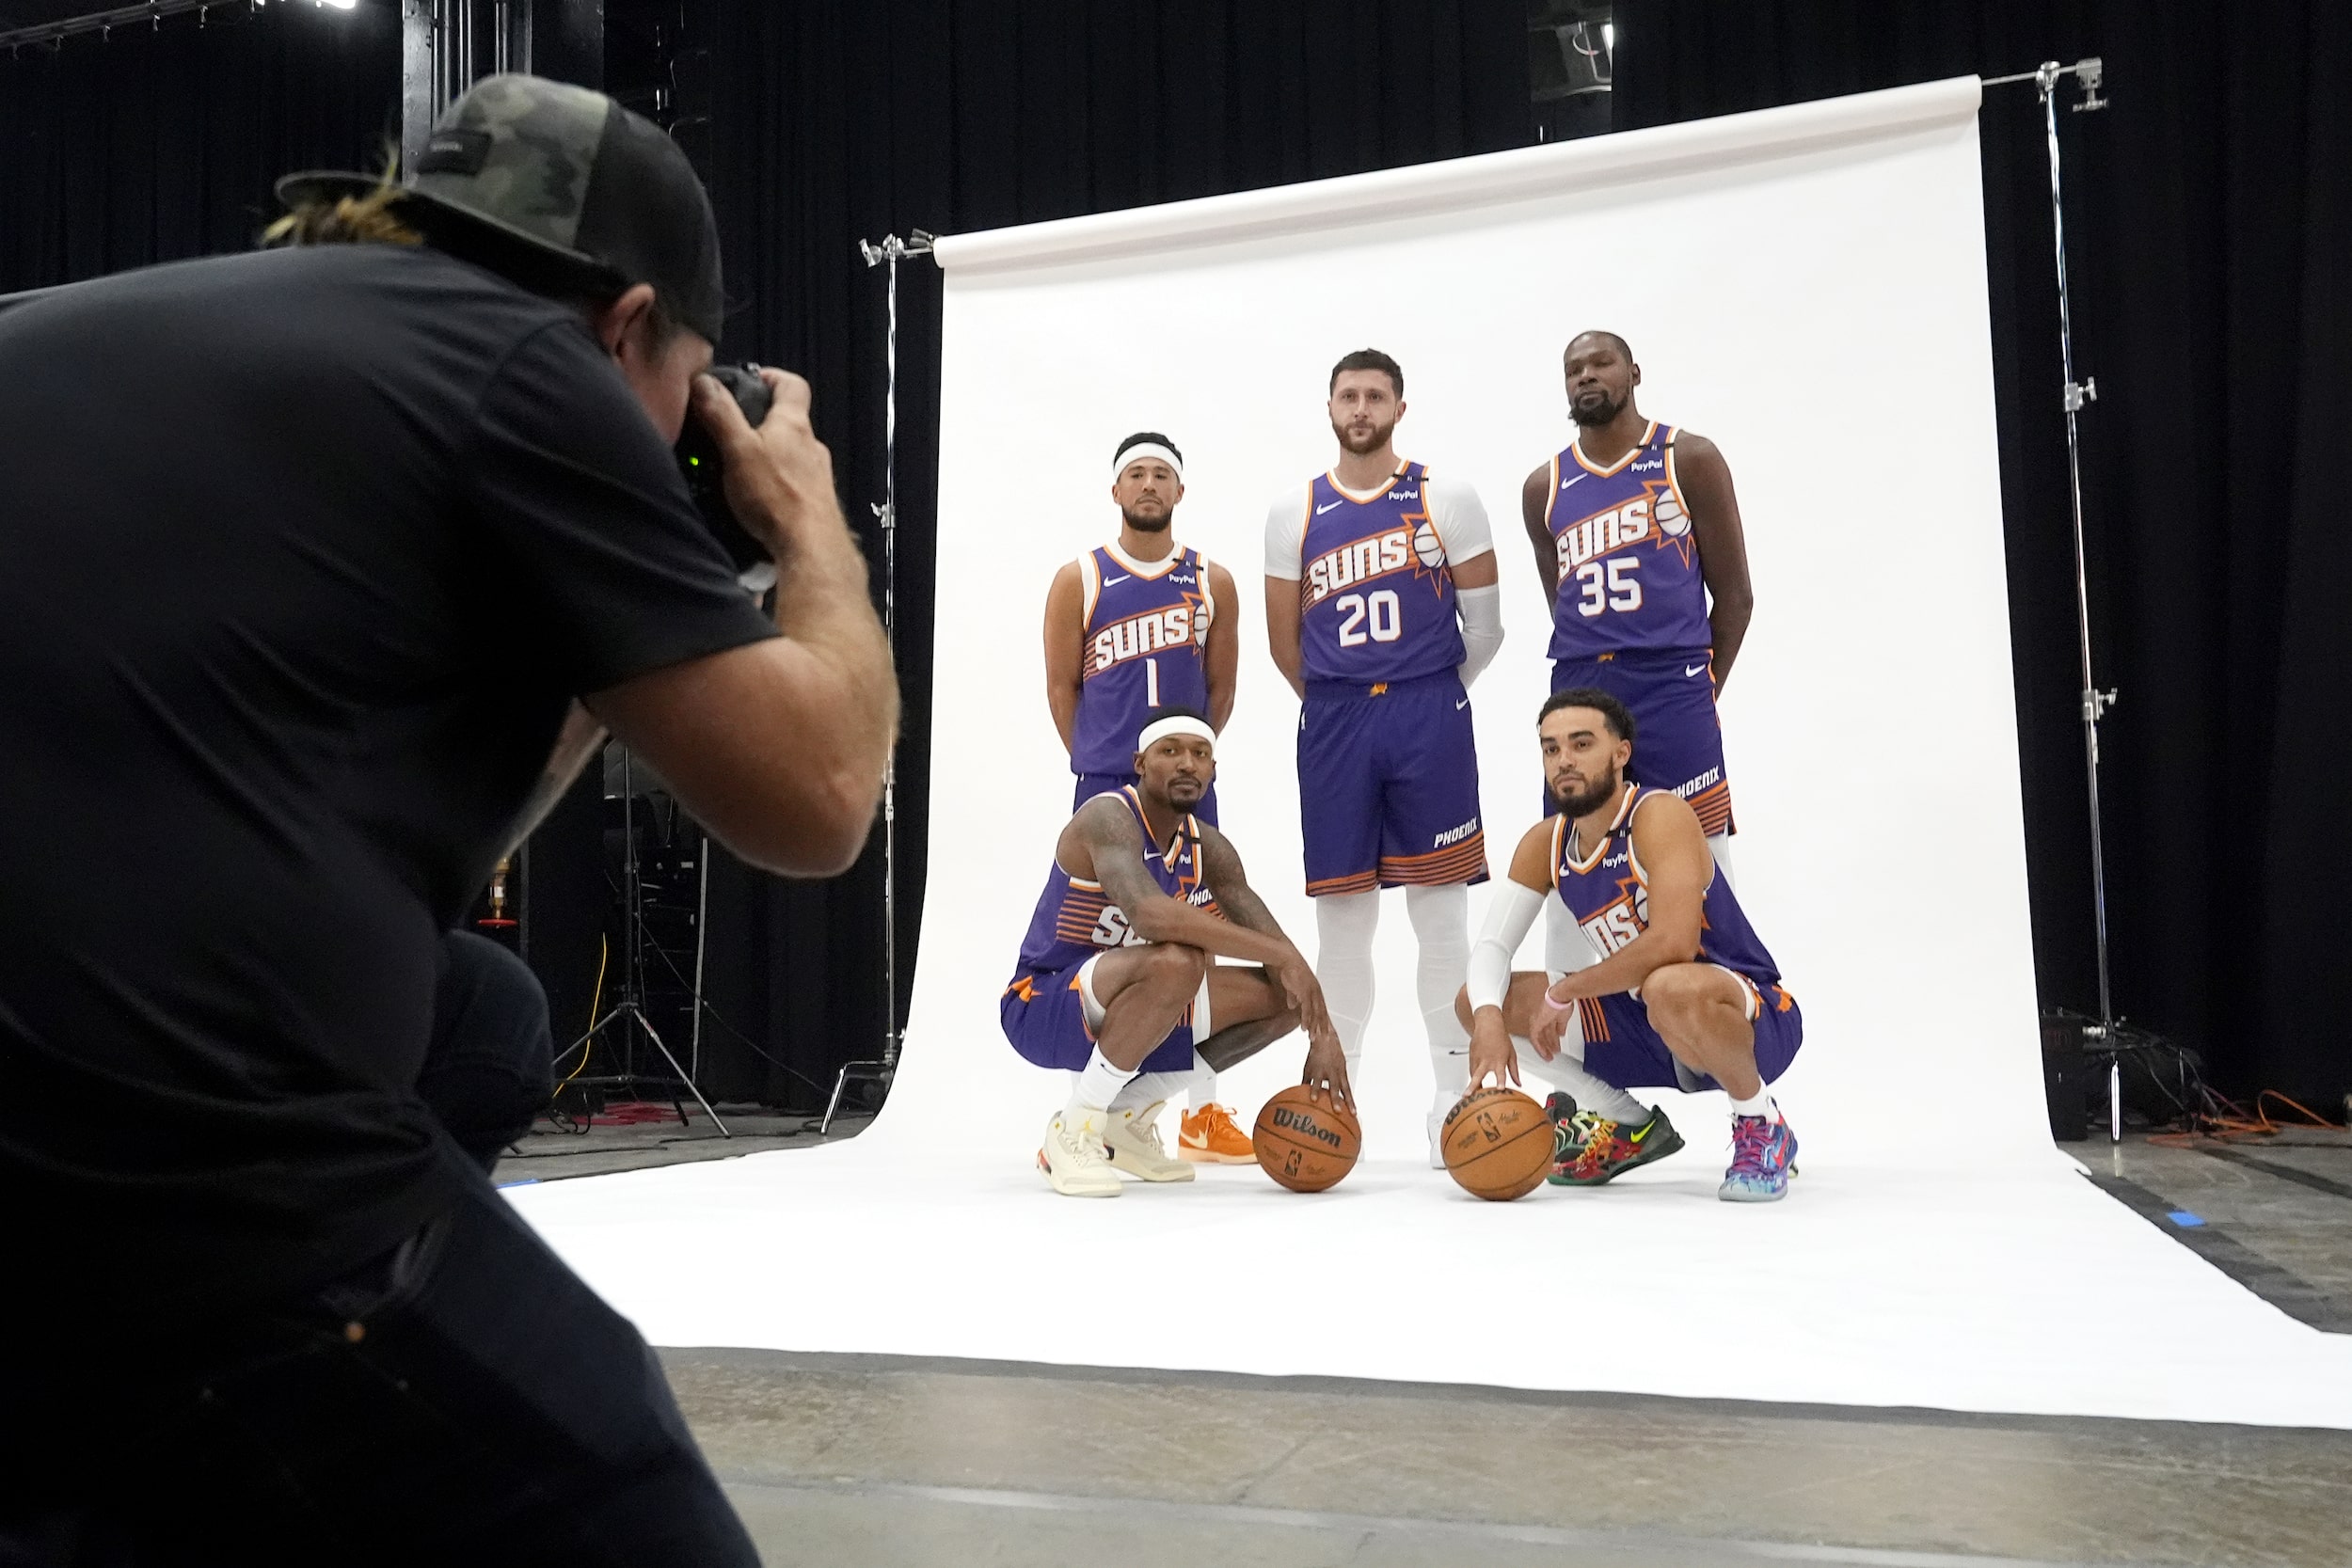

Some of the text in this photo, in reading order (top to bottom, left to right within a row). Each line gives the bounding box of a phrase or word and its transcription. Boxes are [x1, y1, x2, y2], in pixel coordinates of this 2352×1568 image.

[1630, 459, 1663, 472] PayPal
[1388, 490, 1419, 501] PayPal
[1168, 573, 1196, 585] PayPal
[1309, 531, 1408, 601] SUNS
[1576, 557, 1643, 617] 35
[1336, 589, 1402, 646] 20
[1095, 607, 1190, 671] SUNS
[1146, 657, 1161, 707] 1
[1433, 816, 1477, 848] PHOENIX
[1179, 853, 1192, 864] Pal
[1273, 1108, 1342, 1148] Wilson
